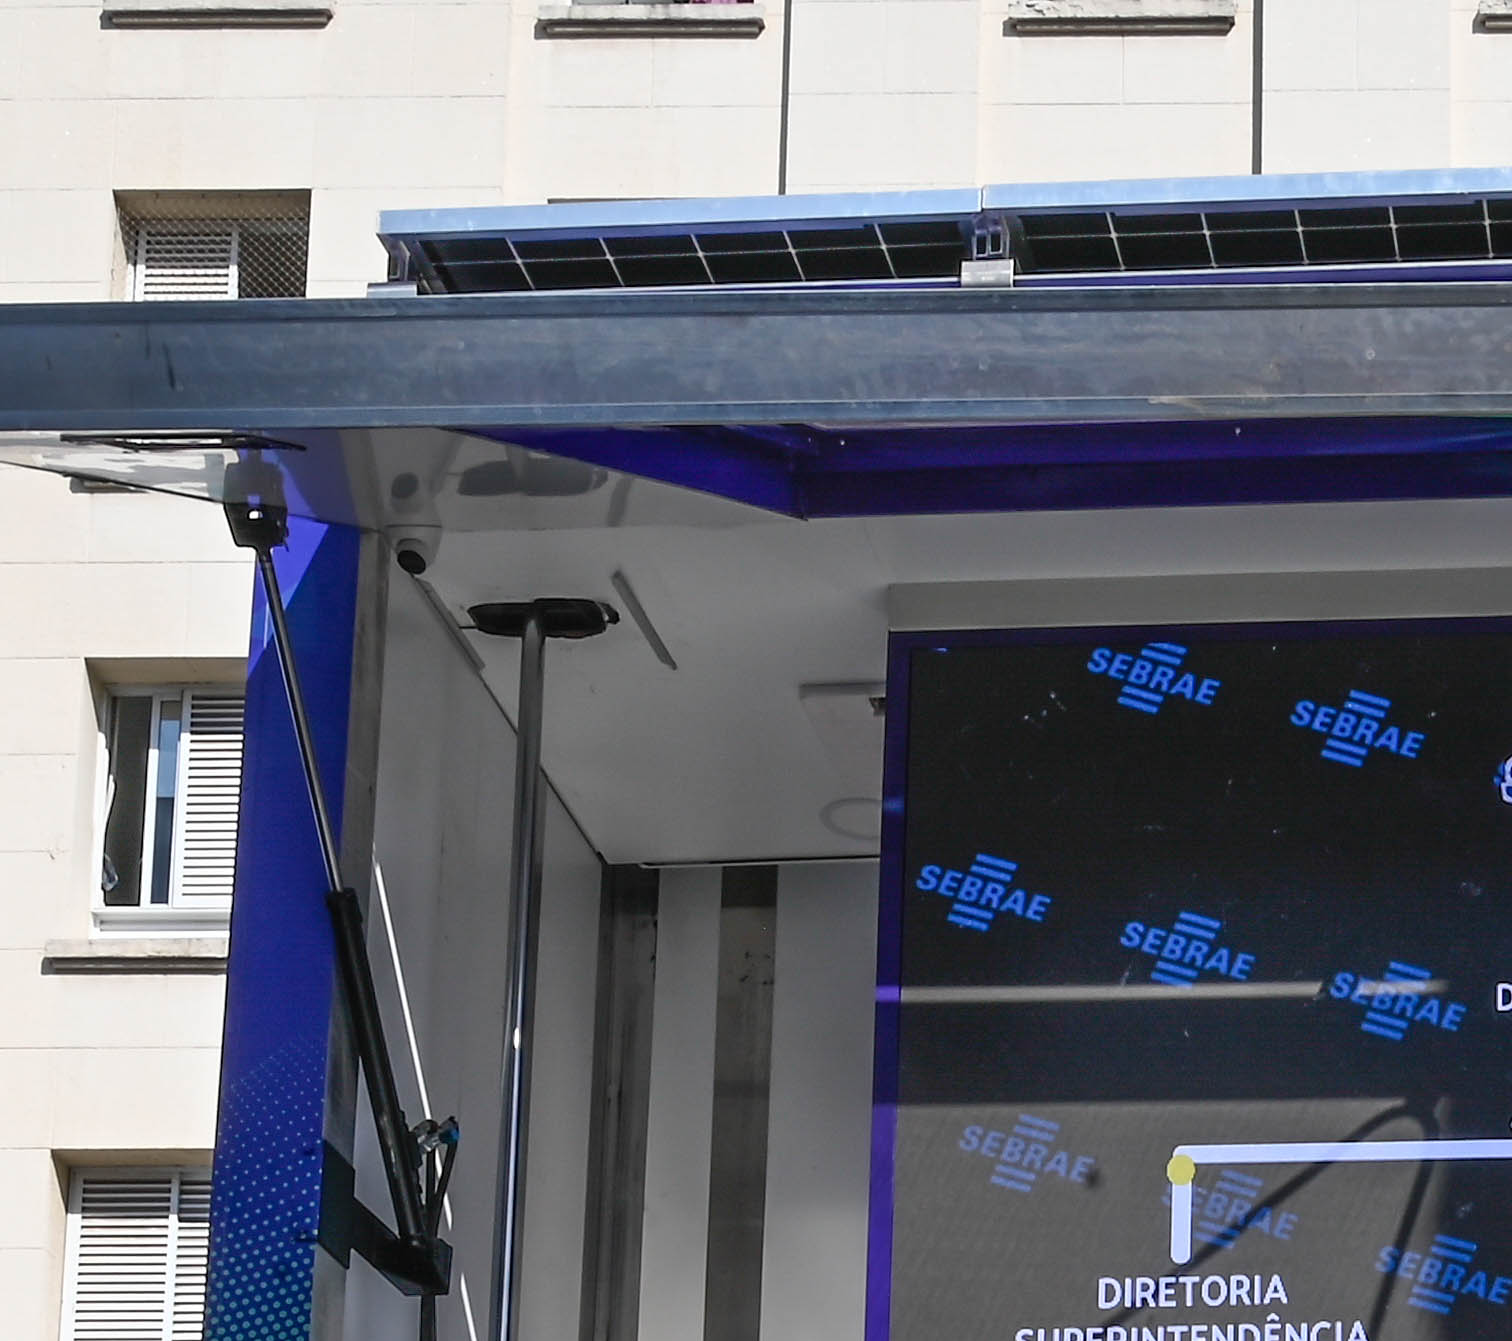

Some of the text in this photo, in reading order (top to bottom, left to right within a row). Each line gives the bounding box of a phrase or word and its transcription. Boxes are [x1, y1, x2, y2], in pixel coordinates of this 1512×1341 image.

[1087, 646, 1221, 706] SEBRAE
[1289, 700, 1425, 758] SEBRAE
[915, 864, 1051, 922] SEBRAE
[1119, 921, 1256, 981] SEBRAE
[1330, 972, 1466, 1032] SEBRAE
[958, 1125, 1096, 1183] SEBRAE
[1097, 1274, 1288, 1310] DIRETORIA
